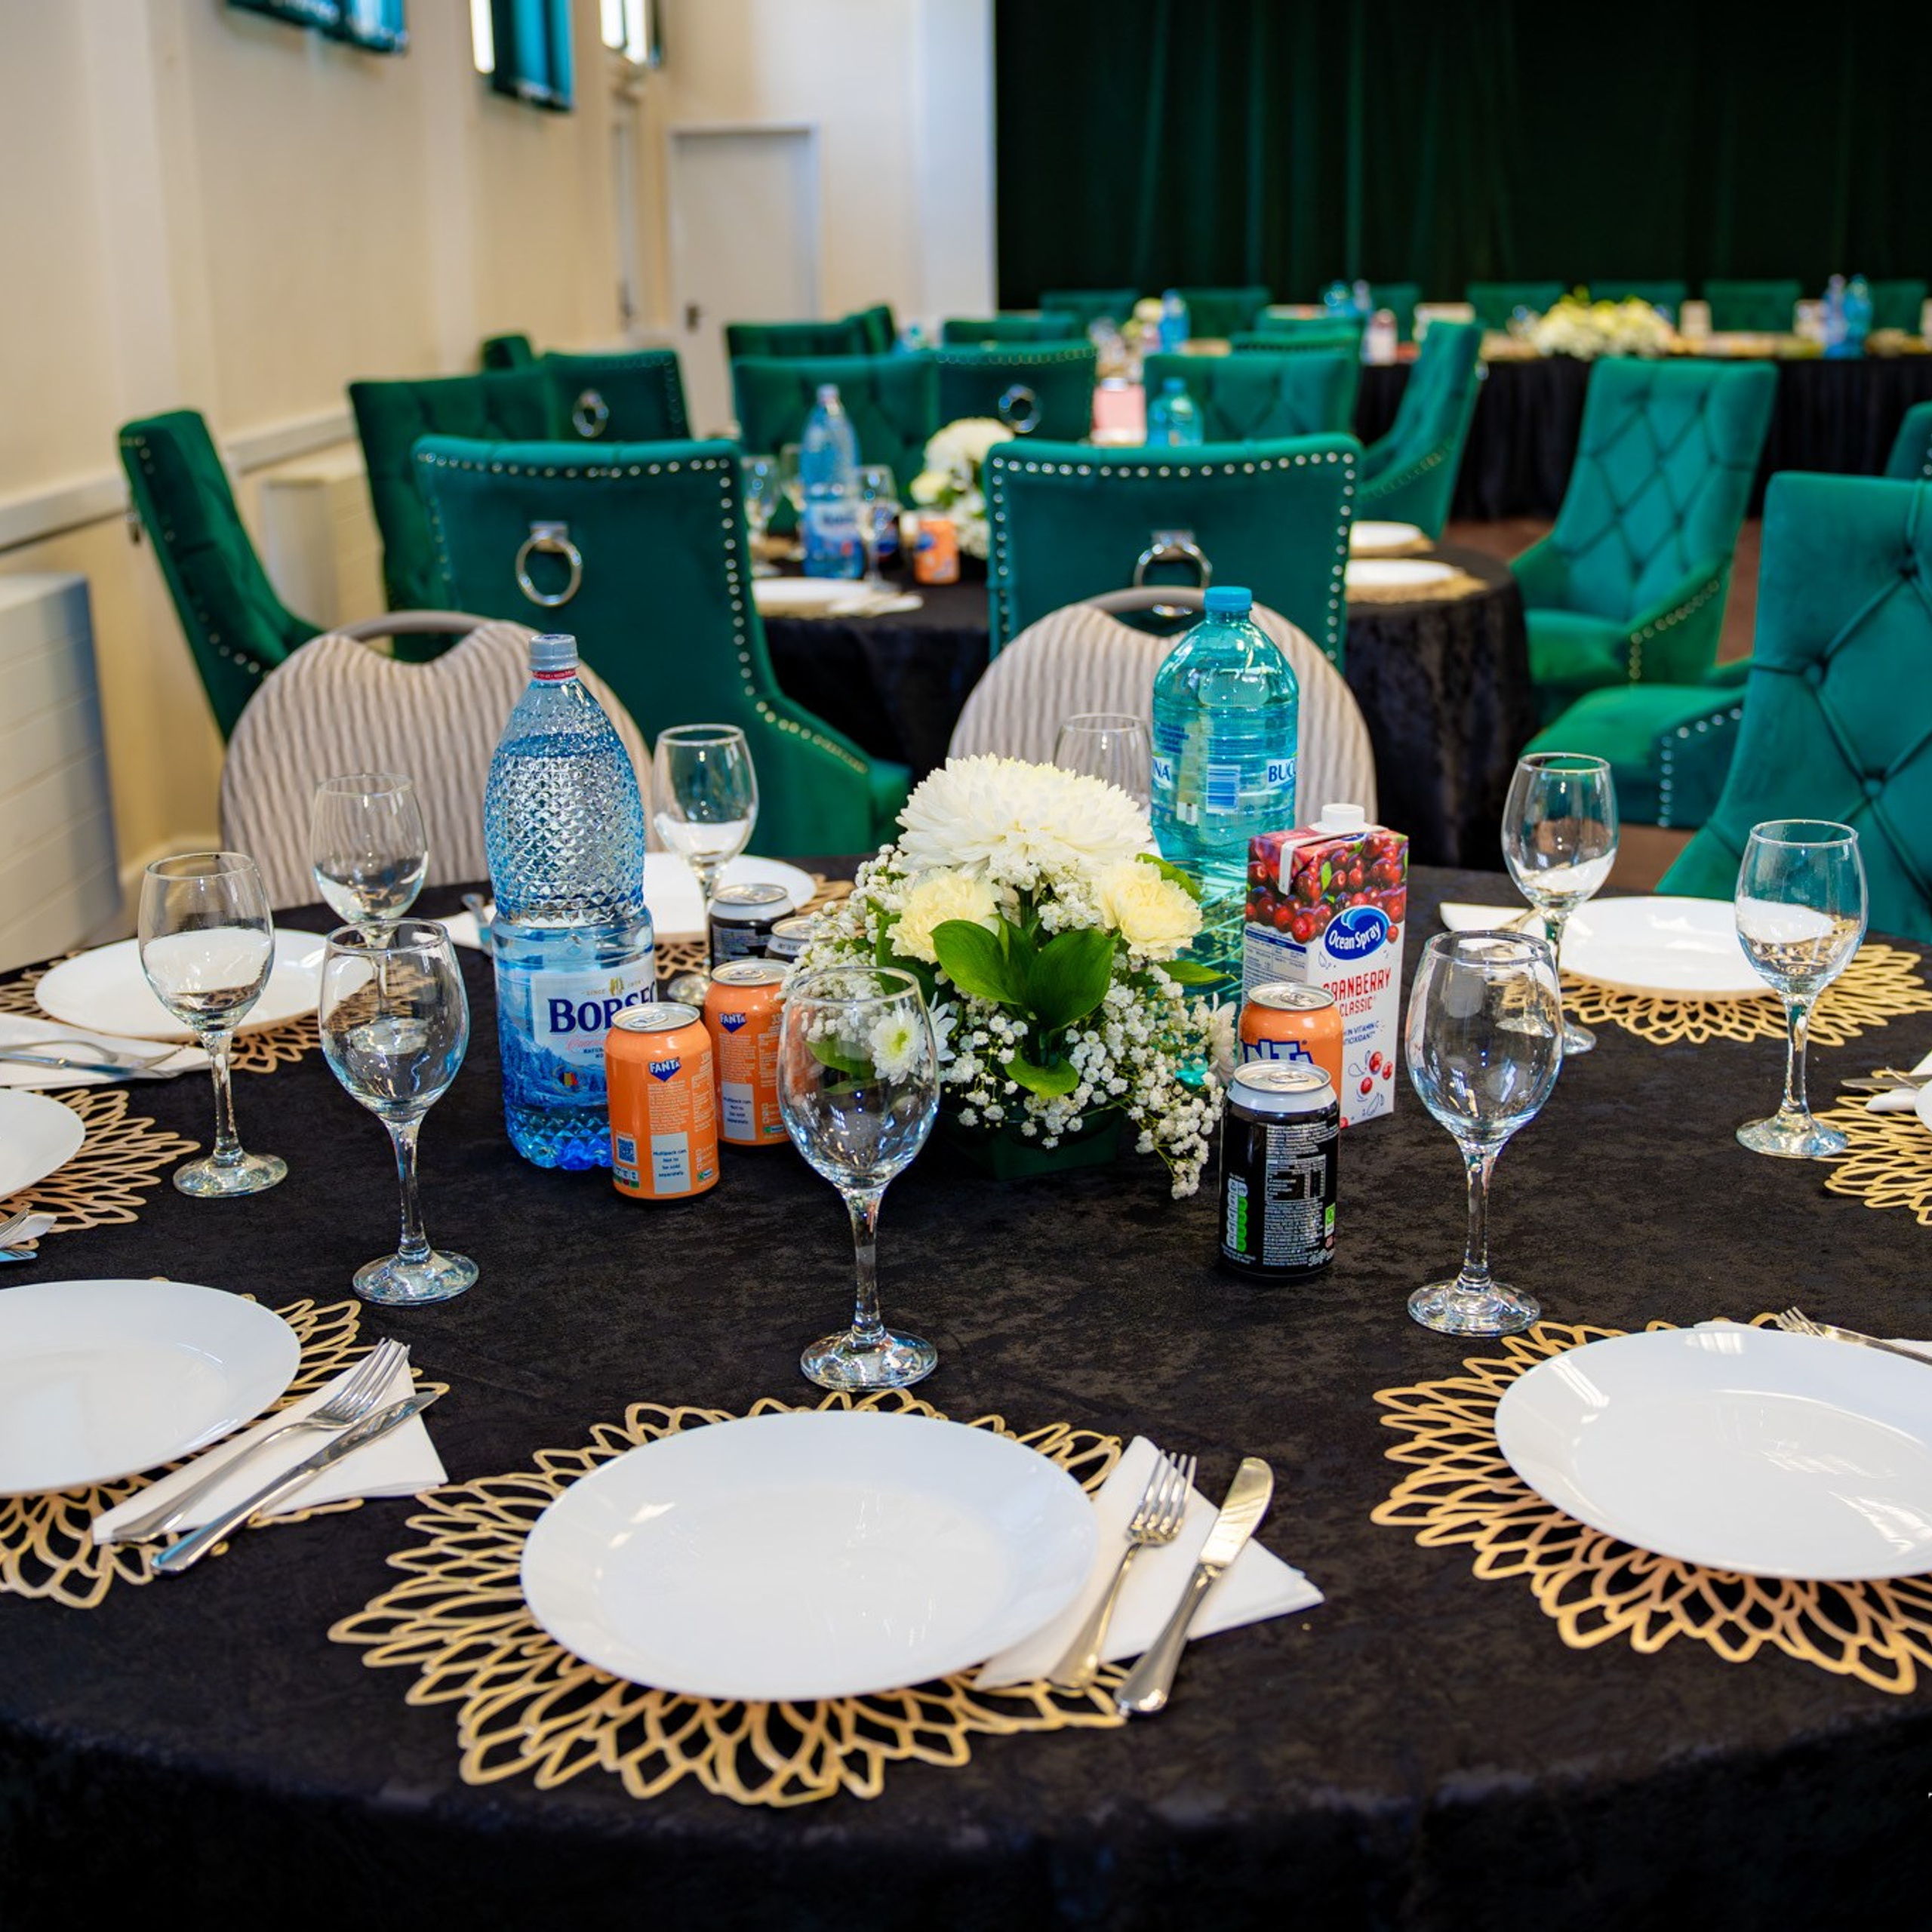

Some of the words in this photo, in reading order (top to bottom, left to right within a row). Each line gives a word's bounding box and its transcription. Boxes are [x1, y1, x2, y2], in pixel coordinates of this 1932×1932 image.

[1269, 759, 1297, 783] BUC
[1329, 929, 1355, 949] Ocean
[1355, 921, 1381, 950] Spray
[718, 1013, 746, 1024] FANTA
[649, 1060, 681, 1074] FANTA
